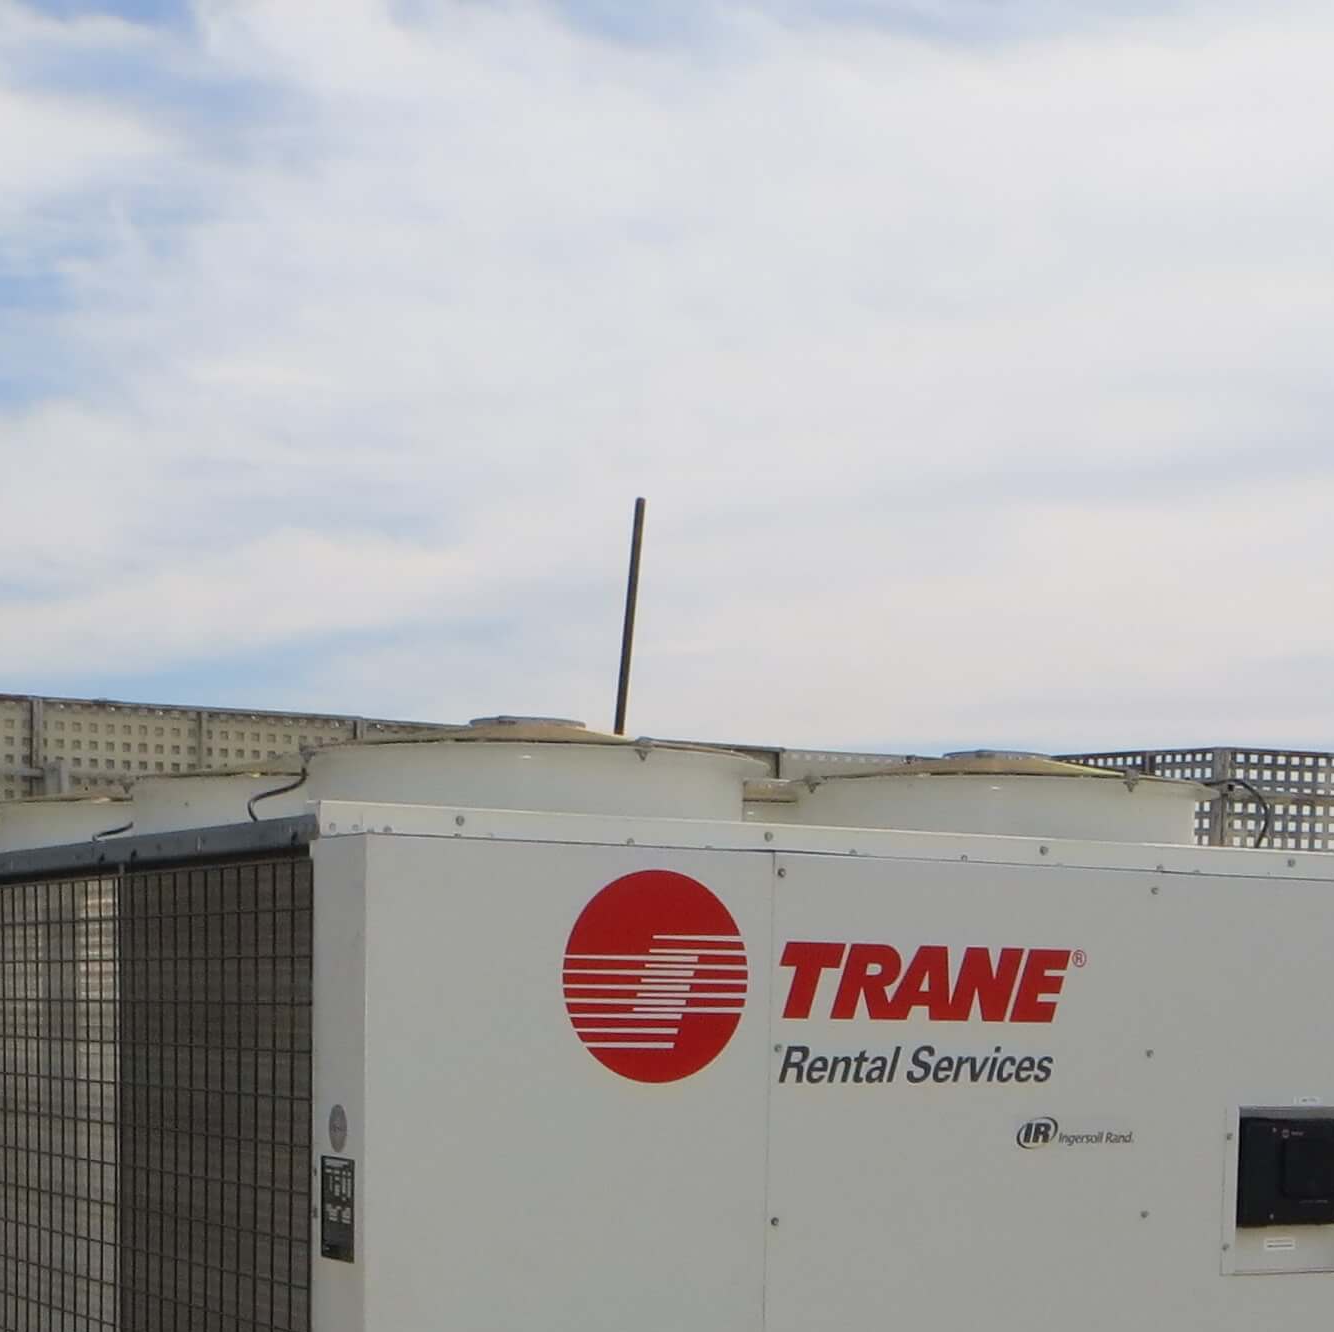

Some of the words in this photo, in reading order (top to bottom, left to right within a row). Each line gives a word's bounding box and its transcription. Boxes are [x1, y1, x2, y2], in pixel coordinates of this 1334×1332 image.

[778, 1046, 902, 1083] Rental
[906, 1046, 1053, 1083] Services
[1023, 1122, 1052, 1143] IR
[1058, 1131, 1104, 1146] Ingersoll
